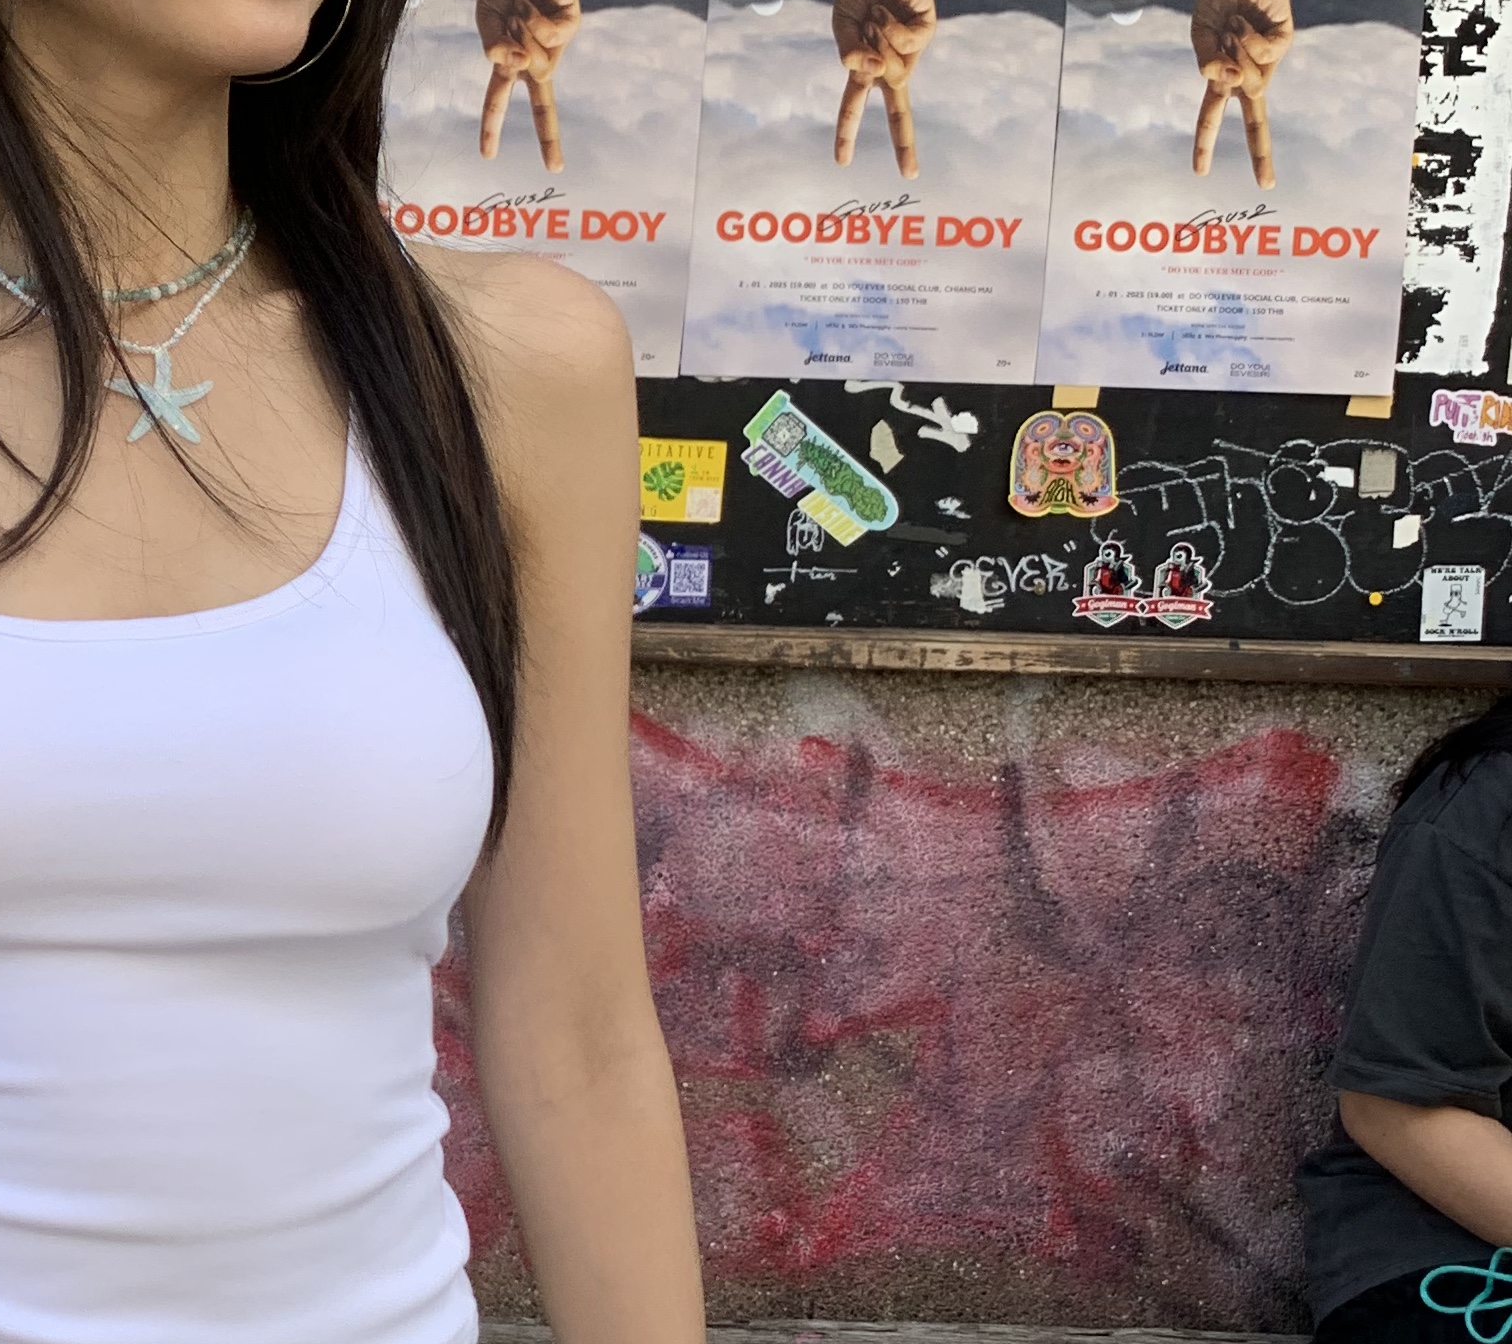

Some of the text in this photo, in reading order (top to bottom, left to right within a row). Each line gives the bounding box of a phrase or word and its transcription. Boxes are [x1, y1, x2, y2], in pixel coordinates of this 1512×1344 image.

[379, 202, 667, 243] OODBYE DOY
[715, 209, 1023, 249] GOODBYE DOY
[1073, 219, 1381, 259] GOODBYE DOY
[887, 283, 916, 292] SOCIAL
[944, 285, 977, 294] CHIANG
[799, 294, 828, 303] TICKET
[1243, 293, 1273, 302] SOCIAL
[1301, 295, 1334, 304] CHIANG
[1156, 305, 1184, 313] TICKET
[1219, 306, 1244, 314] DOOR
